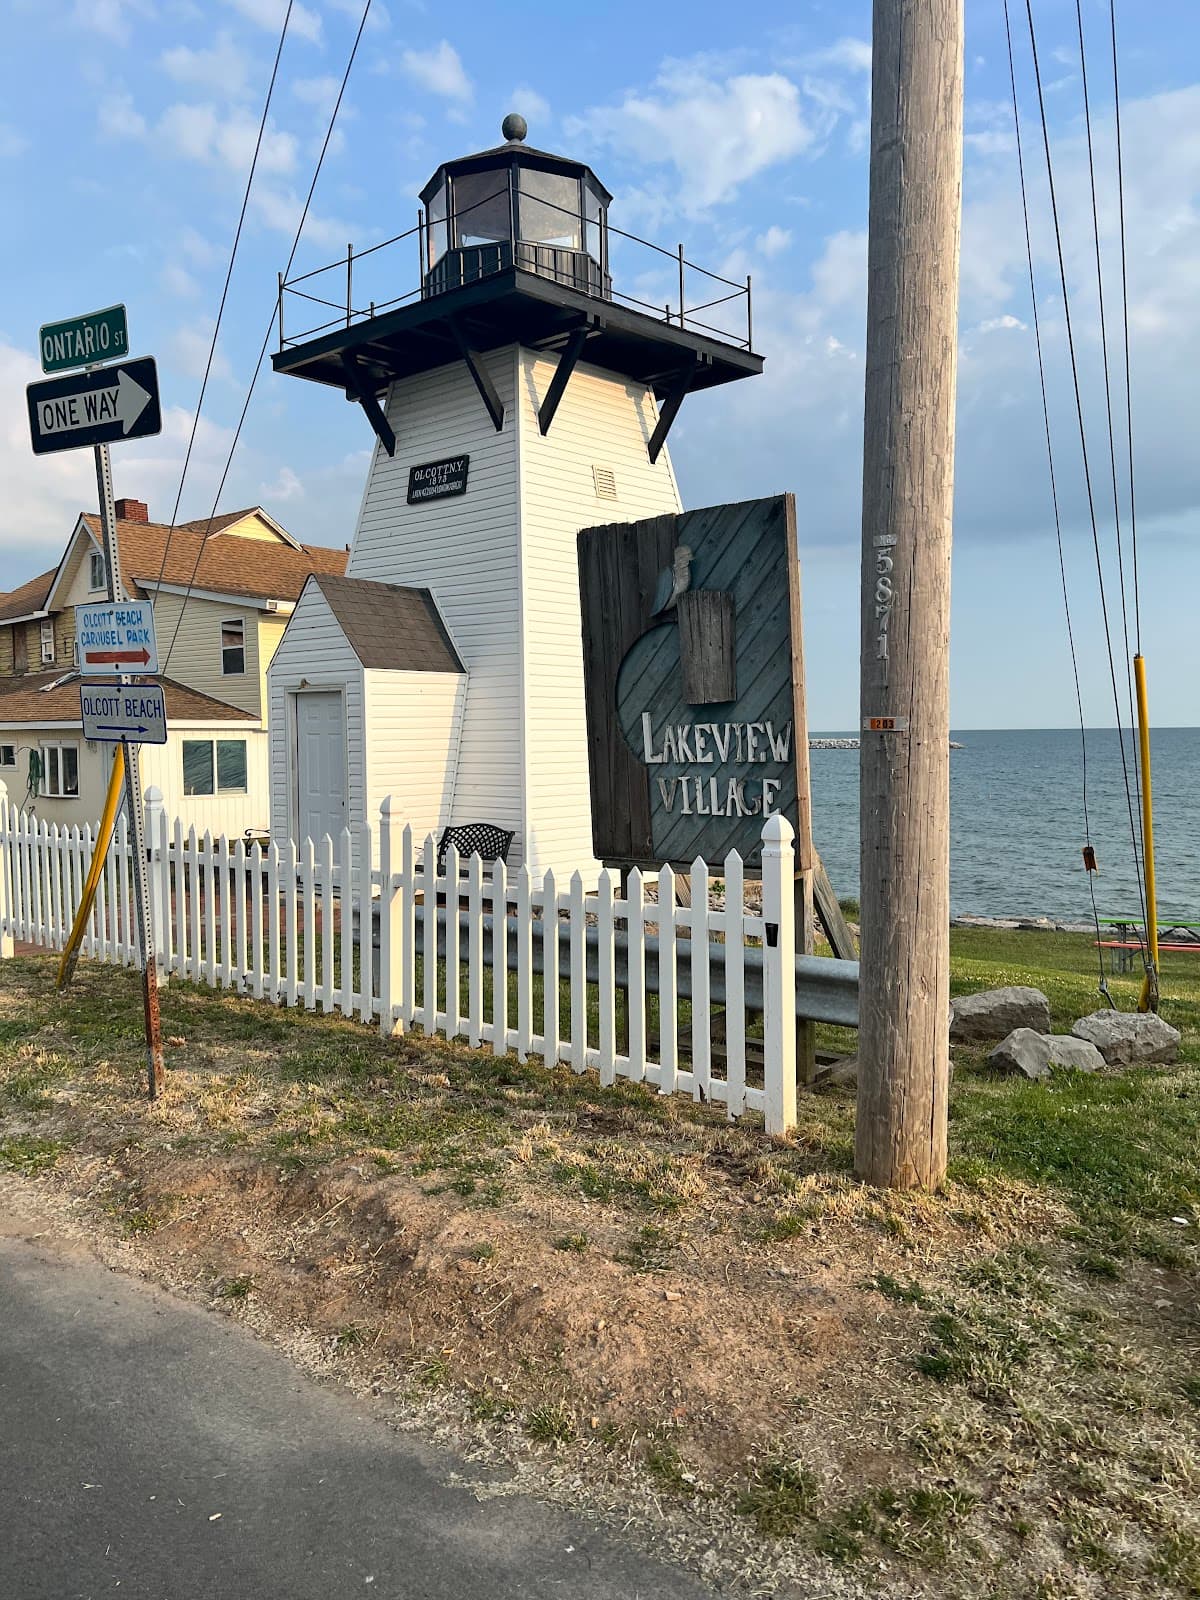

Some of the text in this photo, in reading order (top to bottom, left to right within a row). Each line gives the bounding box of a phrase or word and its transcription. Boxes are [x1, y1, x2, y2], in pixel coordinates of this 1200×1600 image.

[43, 322, 124, 362] ONTARIO ST
[43, 389, 120, 430] ONE WAY
[414, 463, 450, 481] OLCOTT
[83, 610, 142, 628] OLCOTT BEACH
[81, 630, 150, 646] CAROUSEL PARK
[83, 697, 161, 718] OLCOTT BEACH
[641, 712, 792, 763] LAKEVIEW
[656, 776, 782, 818] VILLAGE
